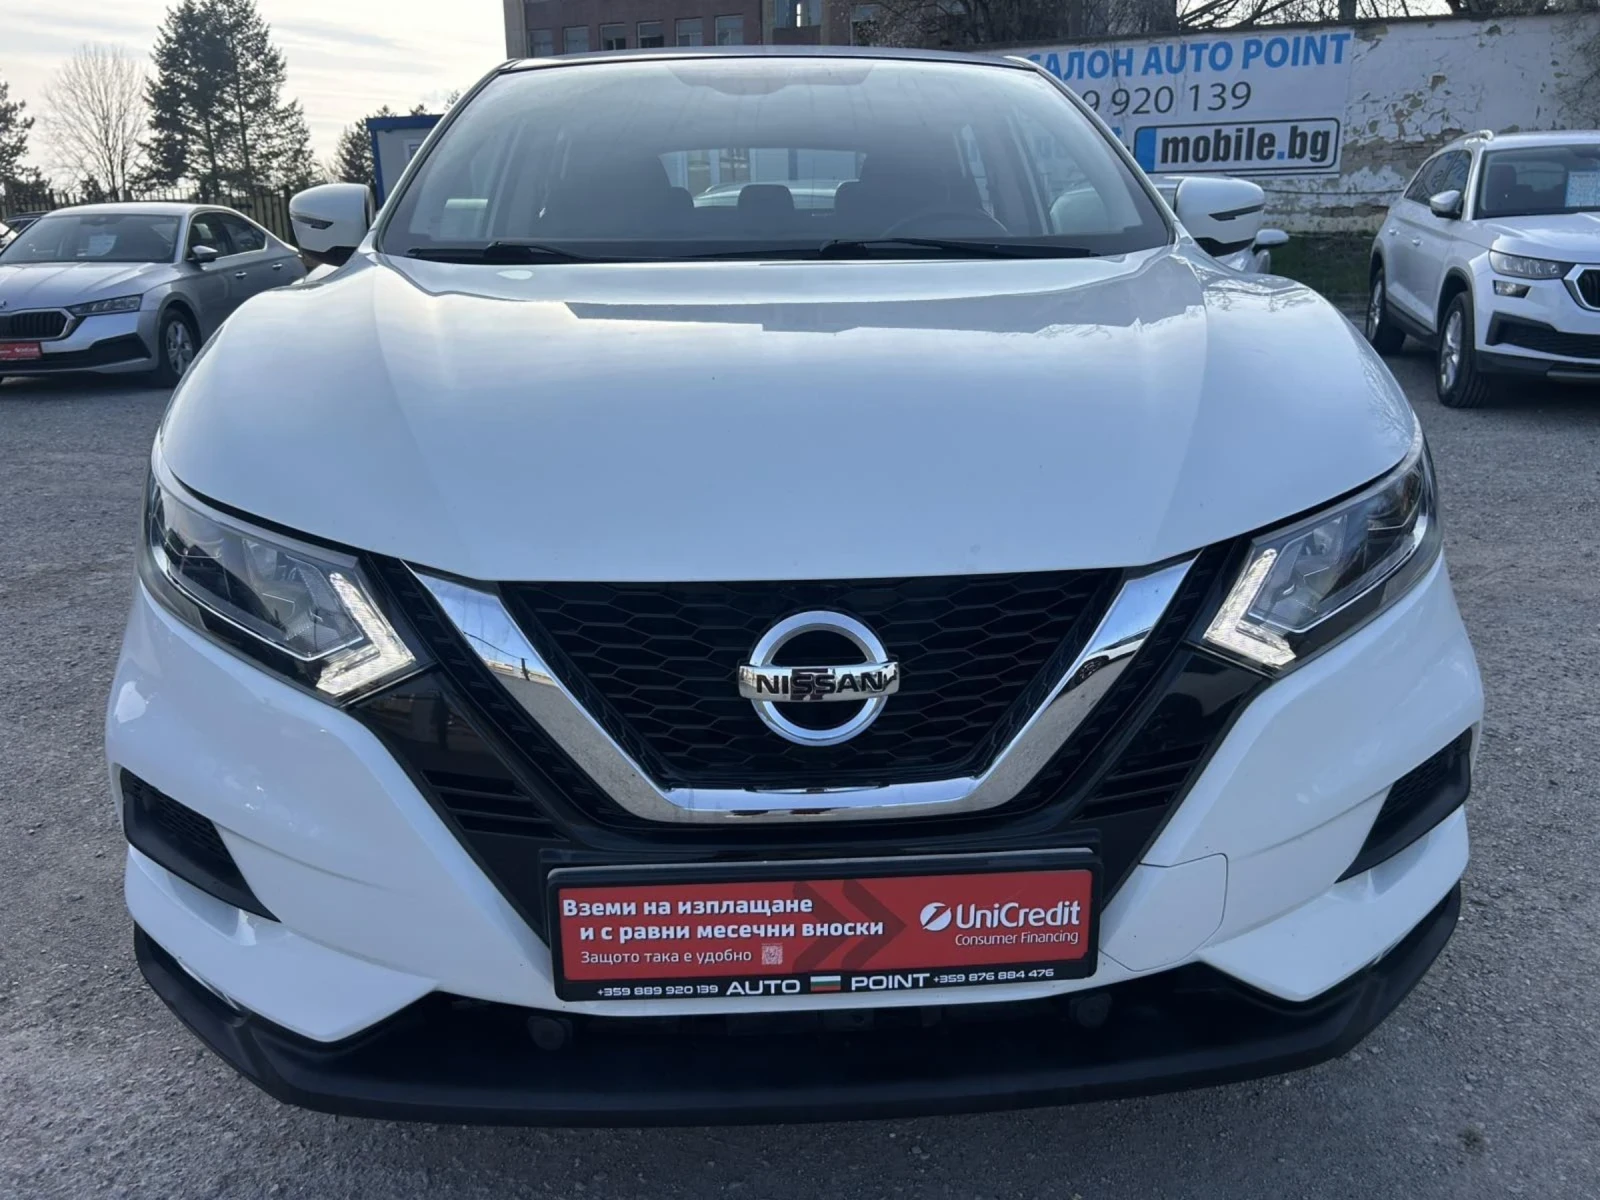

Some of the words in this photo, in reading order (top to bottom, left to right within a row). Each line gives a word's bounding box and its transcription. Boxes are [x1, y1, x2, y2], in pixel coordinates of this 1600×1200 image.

[1141, 40, 1234, 76] AUTO
[1242, 33, 1350, 70] POINT
[1111, 86, 1175, 116] 920
[1189, 81, 1251, 112] 139
[1160, 125, 1331, 164] mobile.bg
[756, 671, 884, 695] NISSAN
[563, 899, 636, 916] Вземи
[643, 901, 671, 915] на
[678, 898, 813, 917] изплащане
[955, 900, 1081, 929] UniCredit
[580, 927, 594, 941] и
[601, 926, 613, 940] с
[619, 924, 690, 944] равни
[697, 922, 795, 940] месечни
[802, 921, 884, 937] вноски
[955, 933, 1018, 946] Consumer
[1021, 930, 1079, 945] Financing
[581, 950, 640, 965] Защото
[645, 951, 680, 963] така
[683, 951, 693, 963] е
[696, 948, 752, 965] удобно
[597, 986, 631, 997] +359
[633, 986, 662, 996] 889
[665, 985, 694, 995] 920
[696, 984, 719, 994] 139
[725, 979, 801, 995] AUTO
[851, 972, 931, 991] POINT
[933, 974, 966, 984] +359
[968, 972, 995, 982] 876
[997, 970, 1025, 980] 884
[1028, 968, 1055, 977] 476
